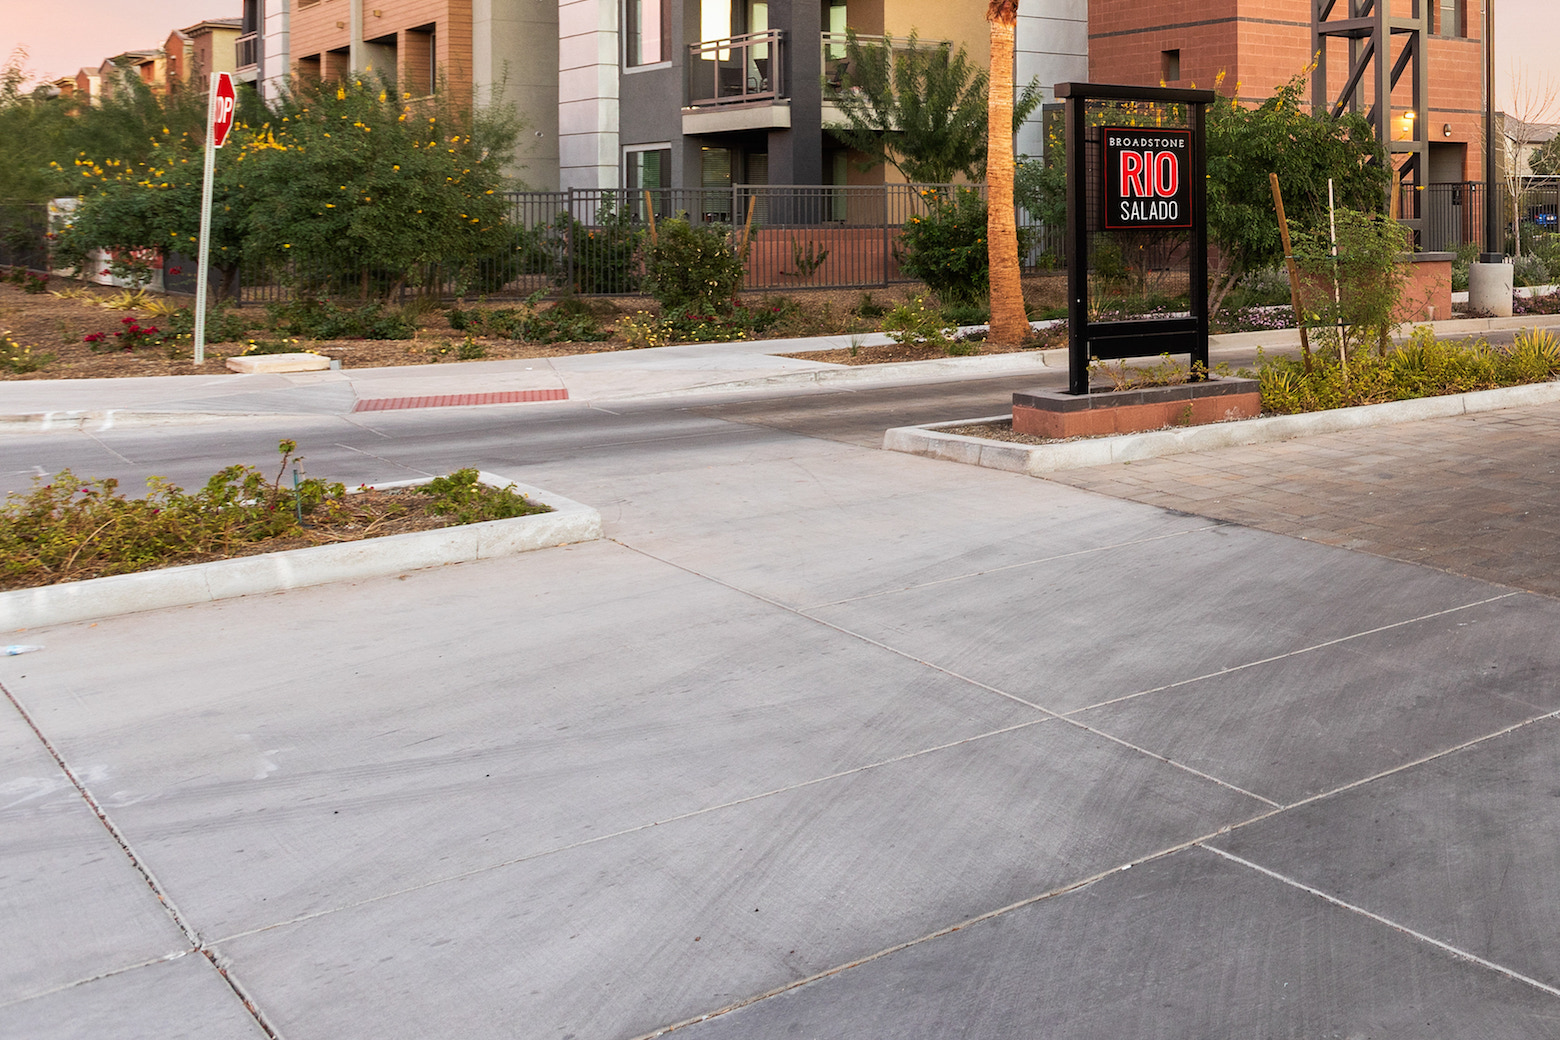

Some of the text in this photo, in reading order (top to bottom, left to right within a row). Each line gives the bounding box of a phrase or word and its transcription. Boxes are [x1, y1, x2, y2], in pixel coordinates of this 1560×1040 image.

[1108, 137, 1186, 148] BROADSTONE
[1119, 150, 1179, 198] RIO
[1120, 200, 1179, 221] SALADO
